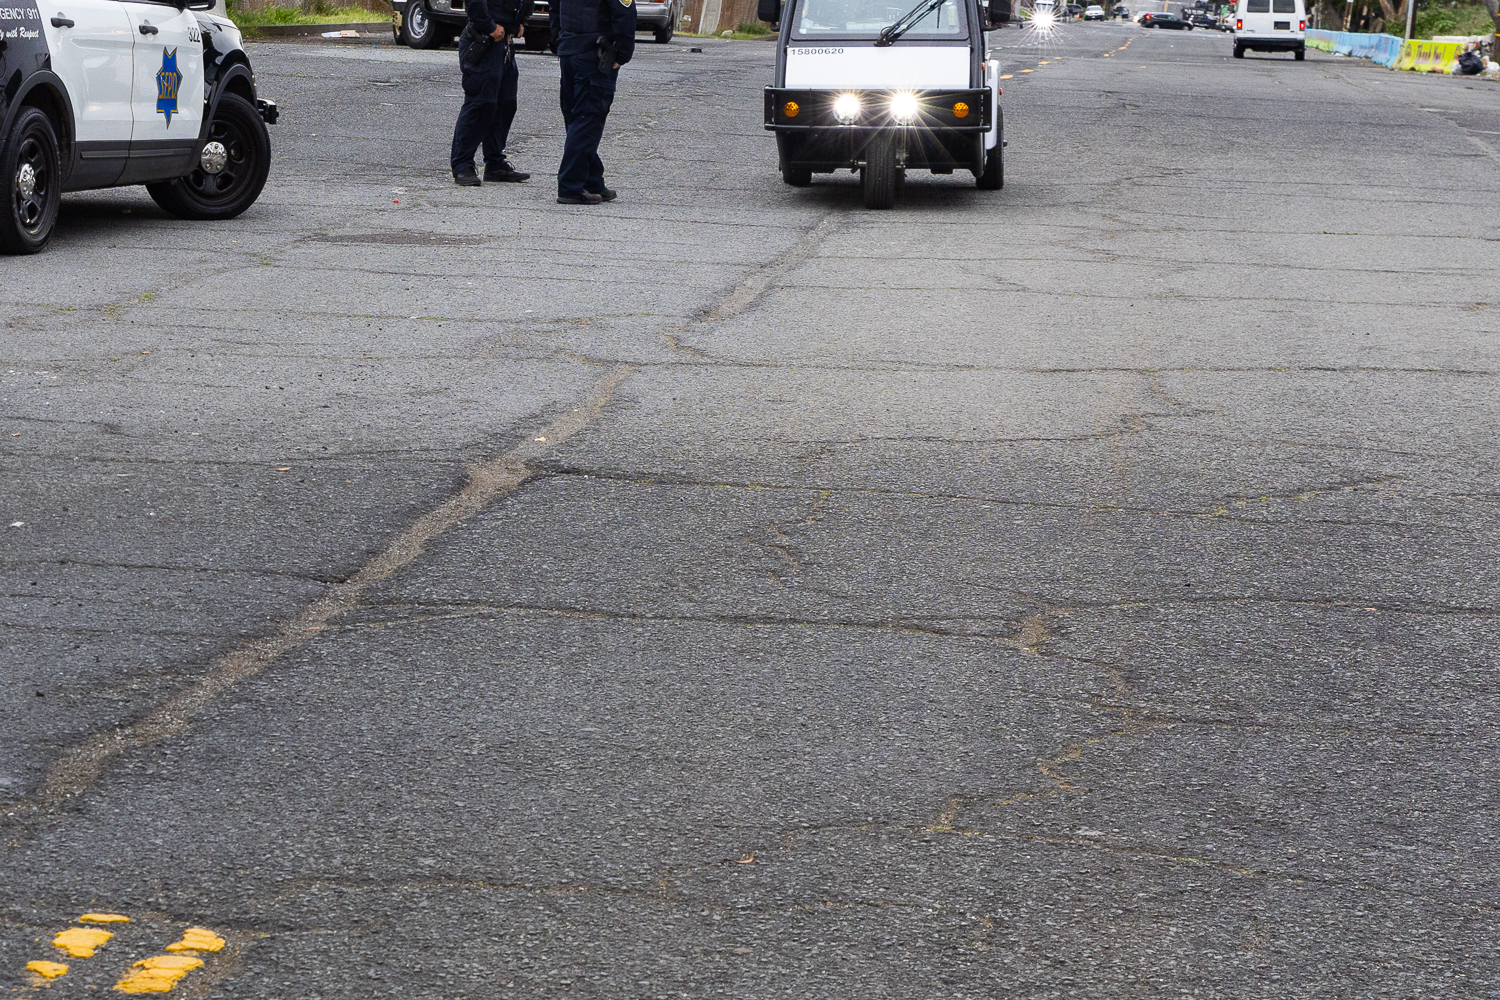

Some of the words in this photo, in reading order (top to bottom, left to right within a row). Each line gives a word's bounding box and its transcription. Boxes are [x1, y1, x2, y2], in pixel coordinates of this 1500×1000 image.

[26, 8, 40, 20] 911
[6, 27, 18, 38] with
[19, 26, 39, 41] Respect
[187, 26, 201, 43] 322
[791, 47, 844, 56] 15800620
